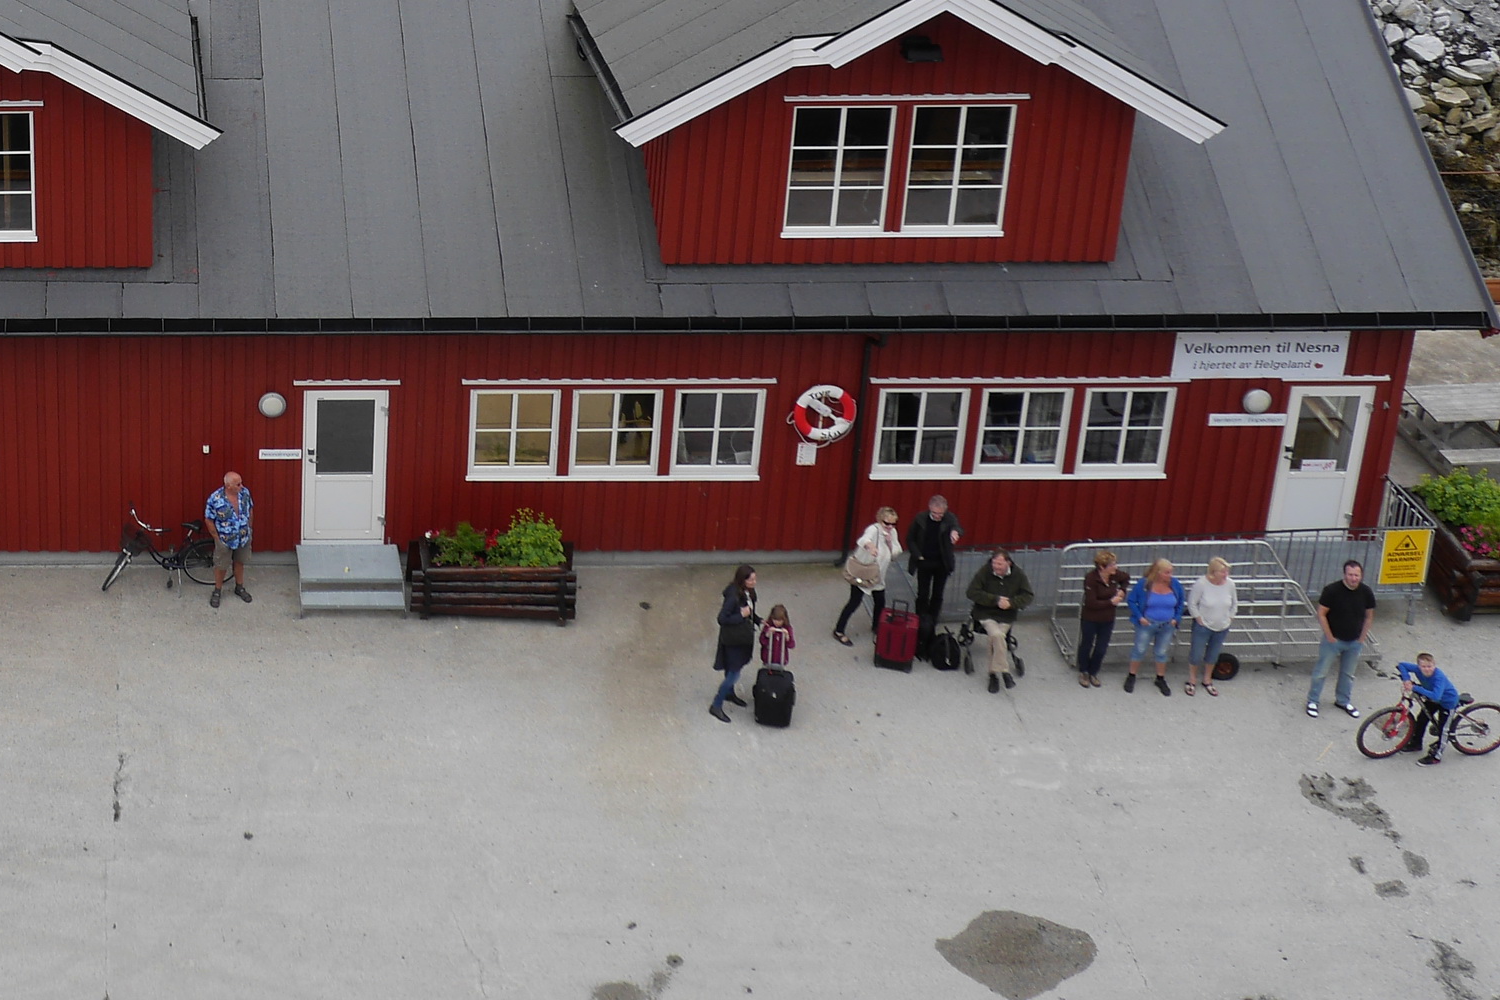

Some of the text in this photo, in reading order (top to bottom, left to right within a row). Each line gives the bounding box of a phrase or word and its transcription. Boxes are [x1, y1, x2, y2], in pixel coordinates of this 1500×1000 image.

[1184, 342, 1340, 354] Velkommen til Nesna
[1199, 360, 1237, 371] hjertet
[1238, 362, 1252, 370] av
[1254, 360, 1312, 371] Helgeland
